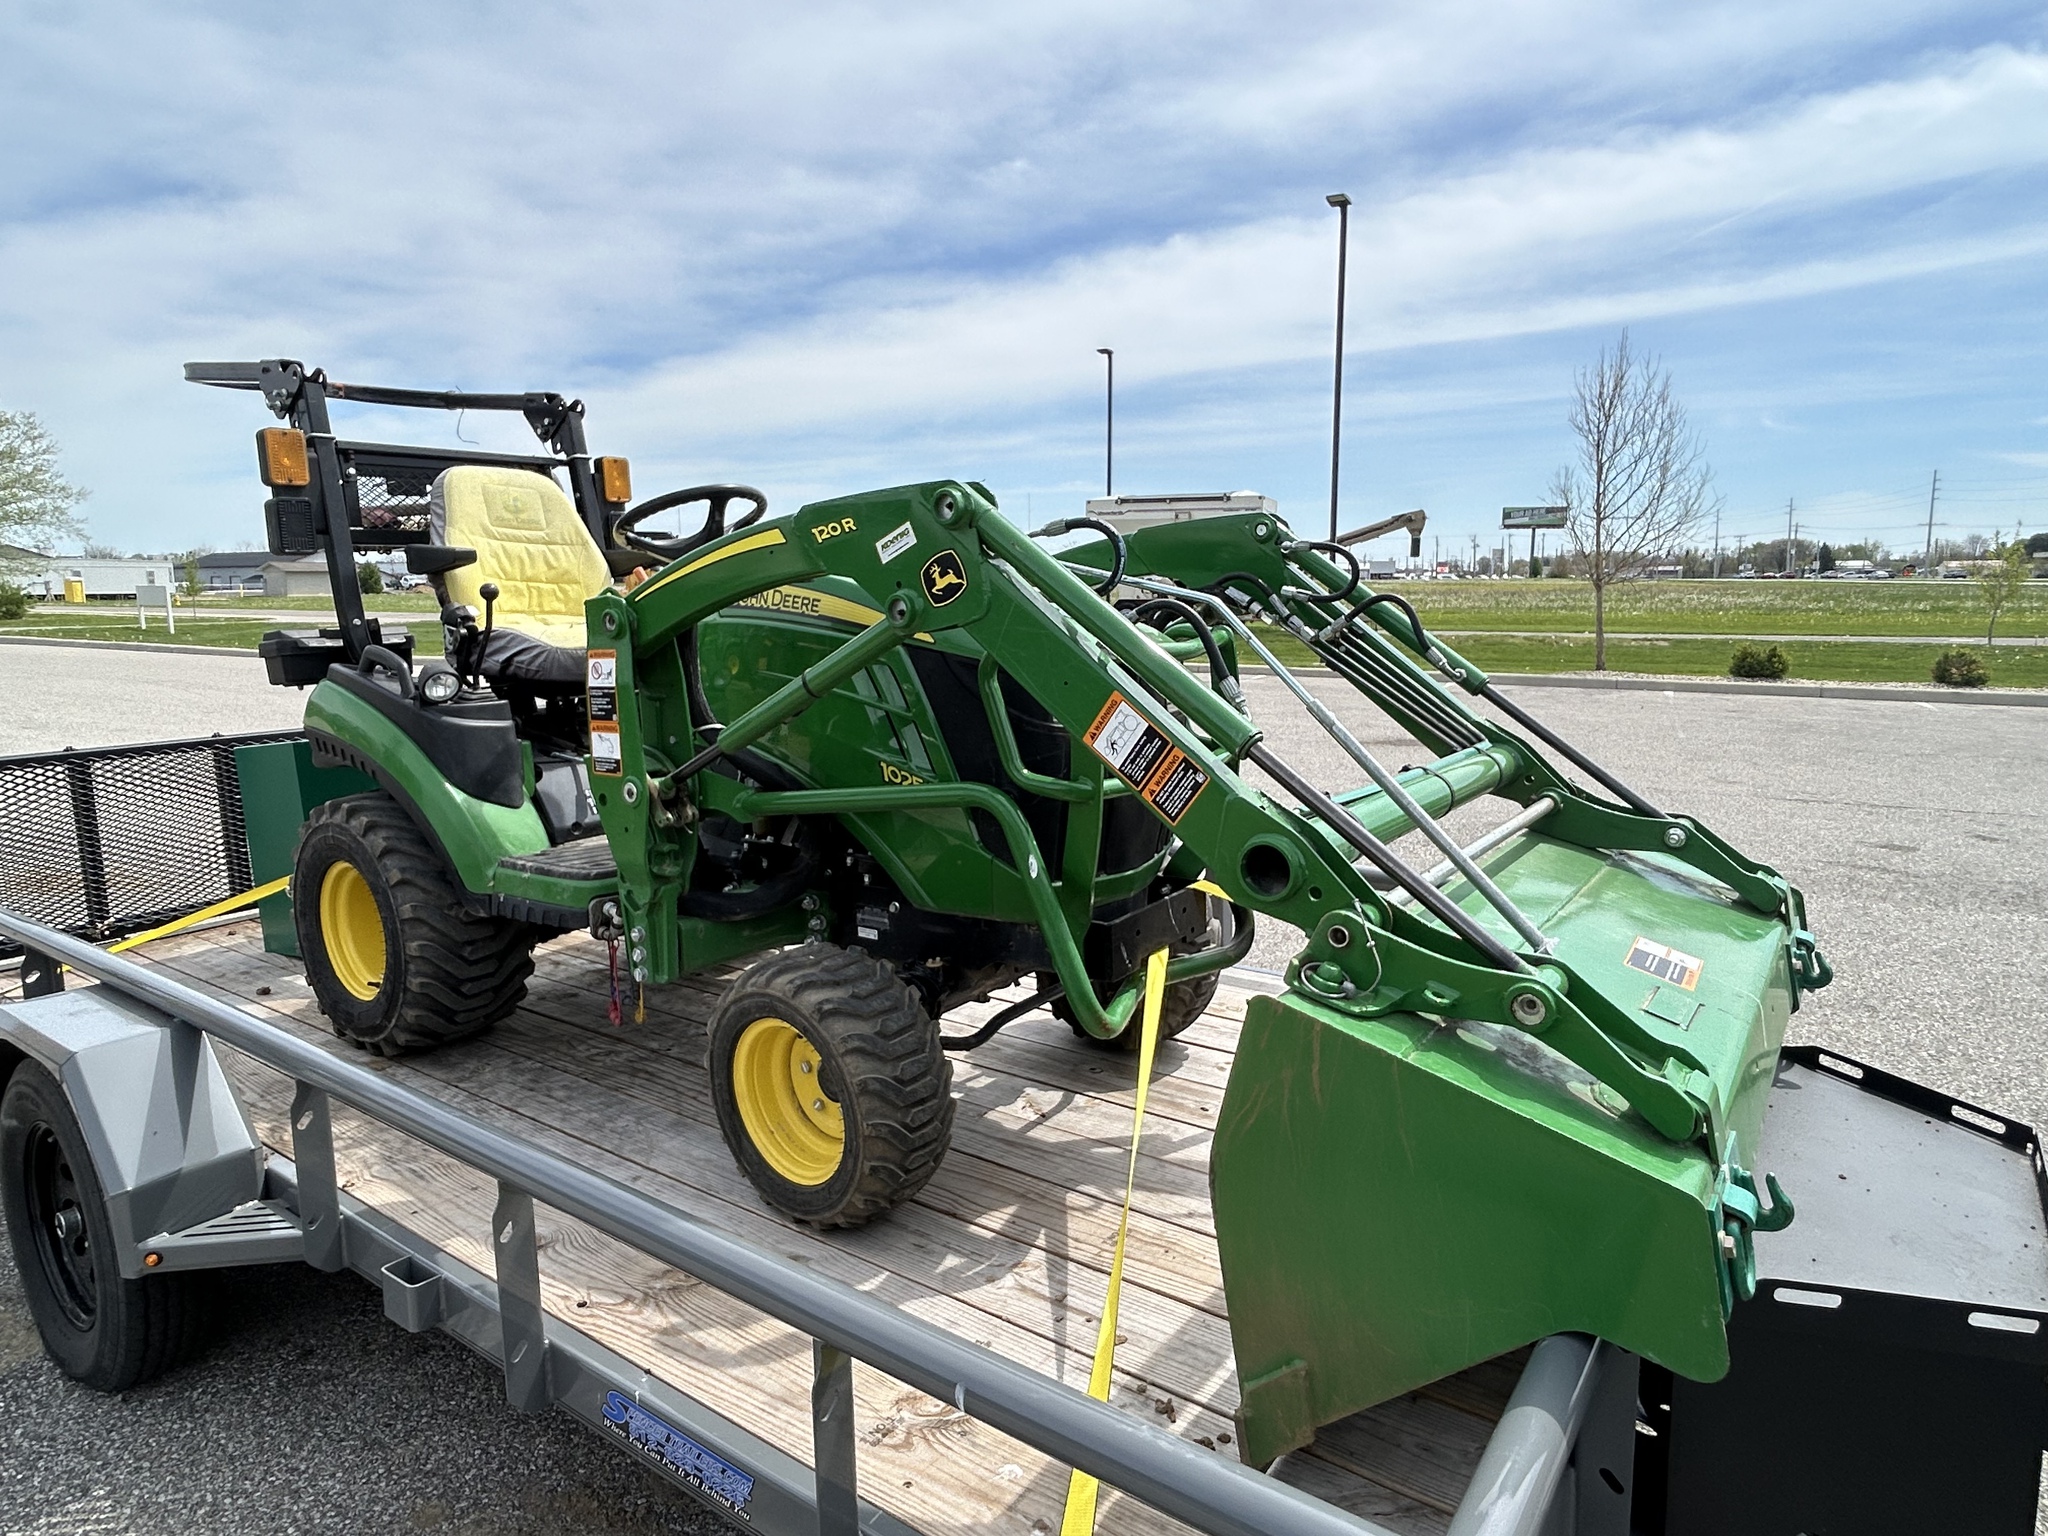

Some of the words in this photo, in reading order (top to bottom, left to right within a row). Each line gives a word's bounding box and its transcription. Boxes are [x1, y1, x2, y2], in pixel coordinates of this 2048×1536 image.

[771, 589, 822, 614] DEERE
[1093, 699, 1118, 734] WARNING
[1153, 754, 1181, 788] WARNING
[603, 1417, 626, 1438] Where
[628, 1435, 642, 1449] You
[644, 1445, 661, 1462] Can
[662, 1457, 676, 1472] Put
[678, 1466, 686, 1478] It
[686, 1474, 700, 1487] All
[701, 1483, 732, 1509] Behind
[733, 1504, 751, 1522] You
